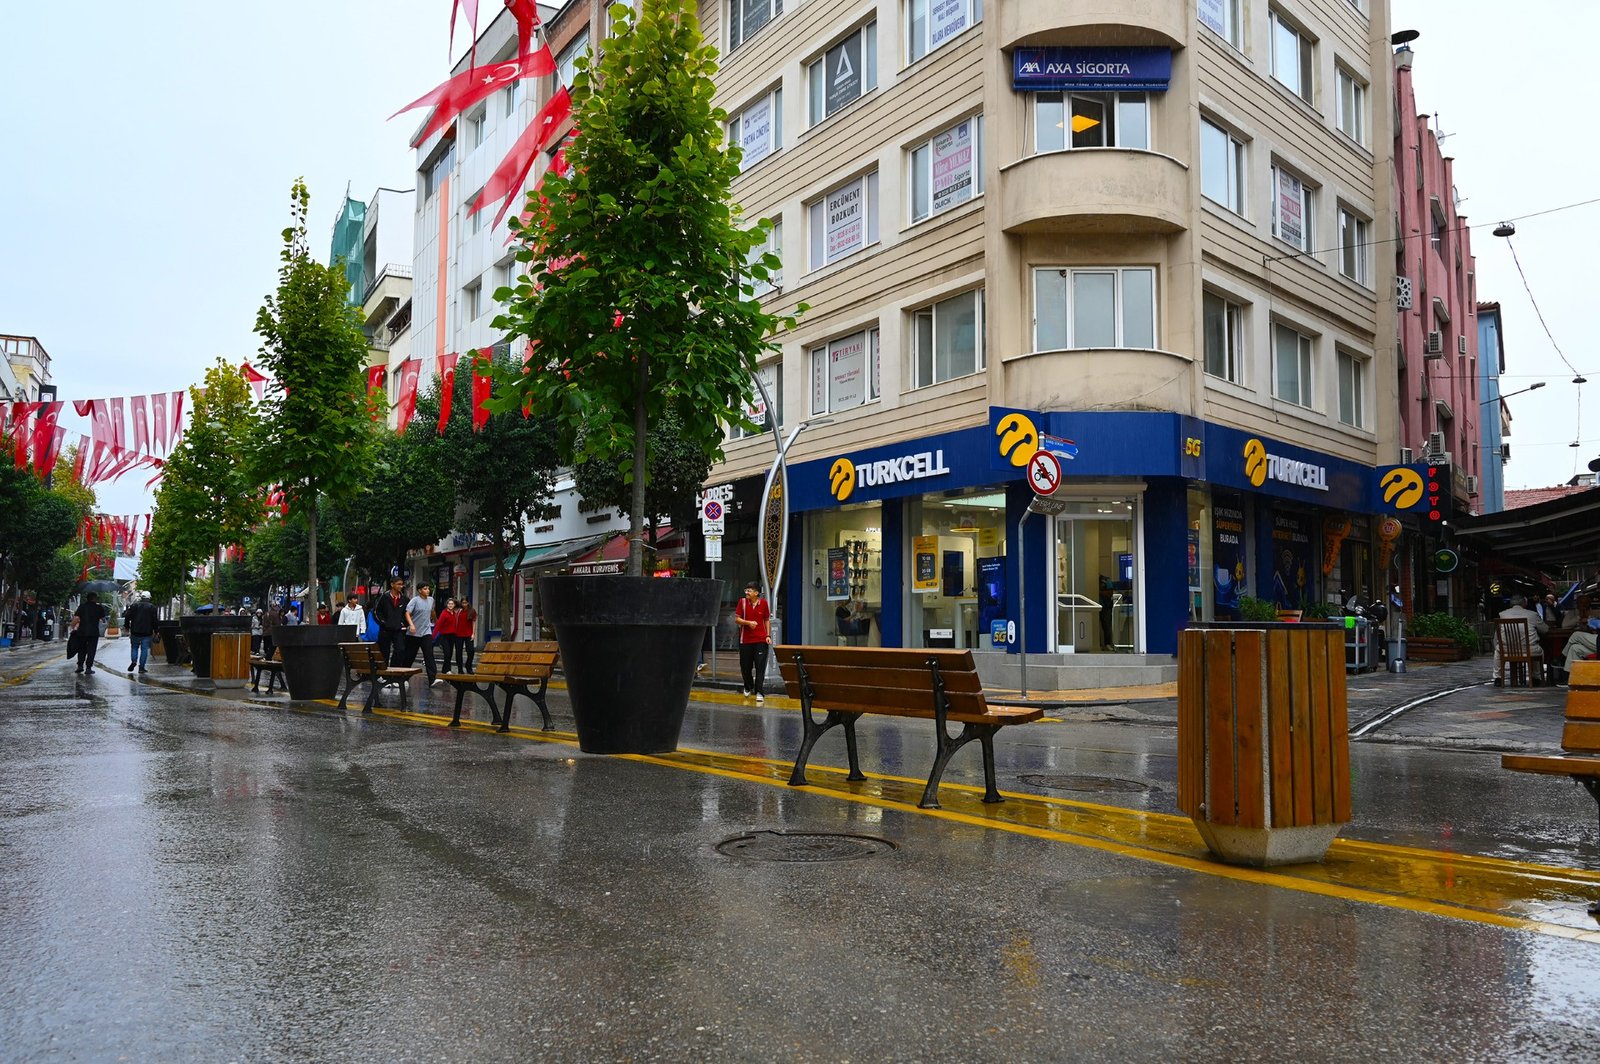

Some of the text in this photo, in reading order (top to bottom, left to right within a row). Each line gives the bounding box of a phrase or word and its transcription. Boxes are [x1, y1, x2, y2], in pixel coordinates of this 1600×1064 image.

[1019, 62, 1041, 73] AXA
[1046, 60, 1131, 74] AXA SİGORTA
[950, 149, 971, 170] YILMAZ
[830, 188, 860, 212] ERCÜMENT
[831, 203, 859, 225] BOZKURT
[840, 342, 863, 357] TİRYAKİ
[1185, 437, 1201, 457] 5G
[856, 449, 950, 488] TURKCELL
[1266, 453, 1329, 491] TURKCELL
[1428, 467, 1441, 521] FOTO
[1214, 507, 1243, 519] IŞIK HIZINDA
[1275, 516, 1288, 527] SÜPER
[1220, 533, 1239, 545] BURADA
[1292, 533, 1309, 543] BURADA
[572, 563, 620, 575] ANKARA KURUYEMİŞ
[993, 631, 1007, 643] 5G
